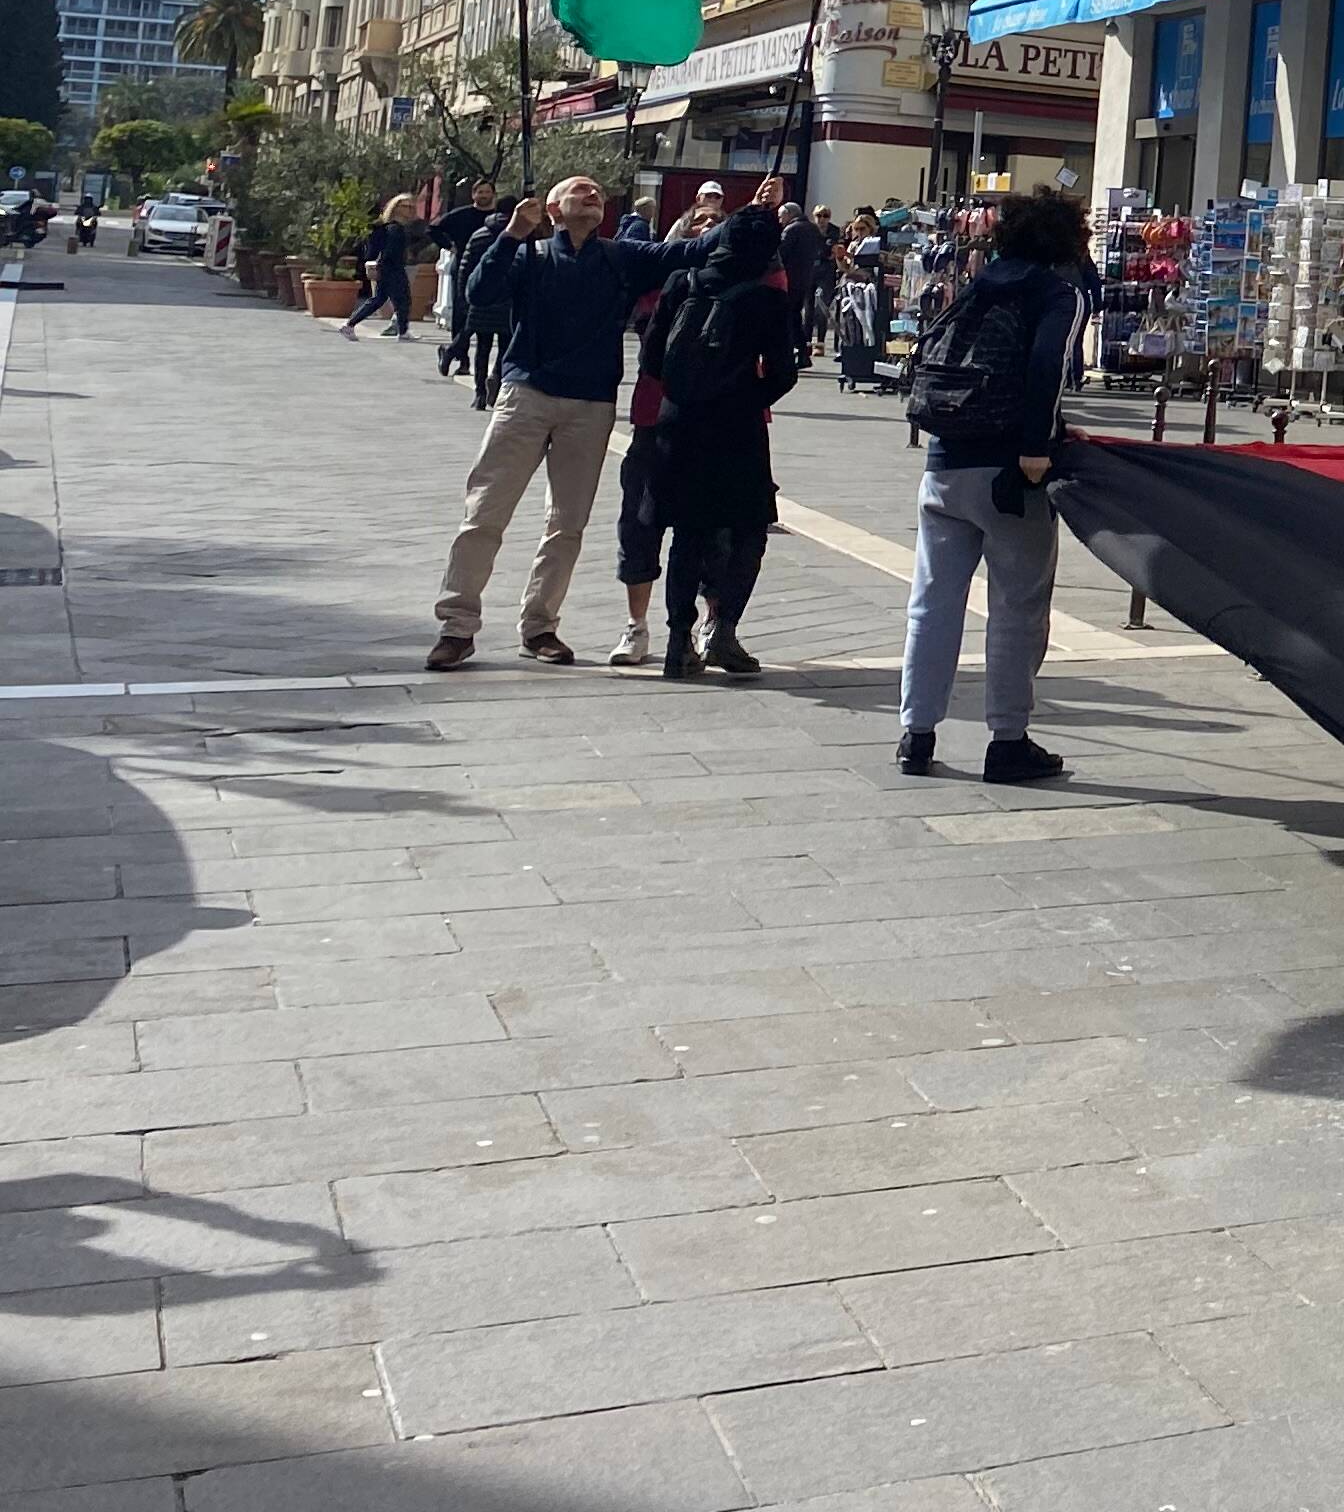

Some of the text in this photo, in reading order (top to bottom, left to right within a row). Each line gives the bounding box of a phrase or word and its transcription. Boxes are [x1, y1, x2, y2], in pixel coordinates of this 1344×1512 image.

[705, 51, 718, 83] LA
[720, 41, 759, 79] PETITE
[958, 39, 1103, 82] LA PETI
